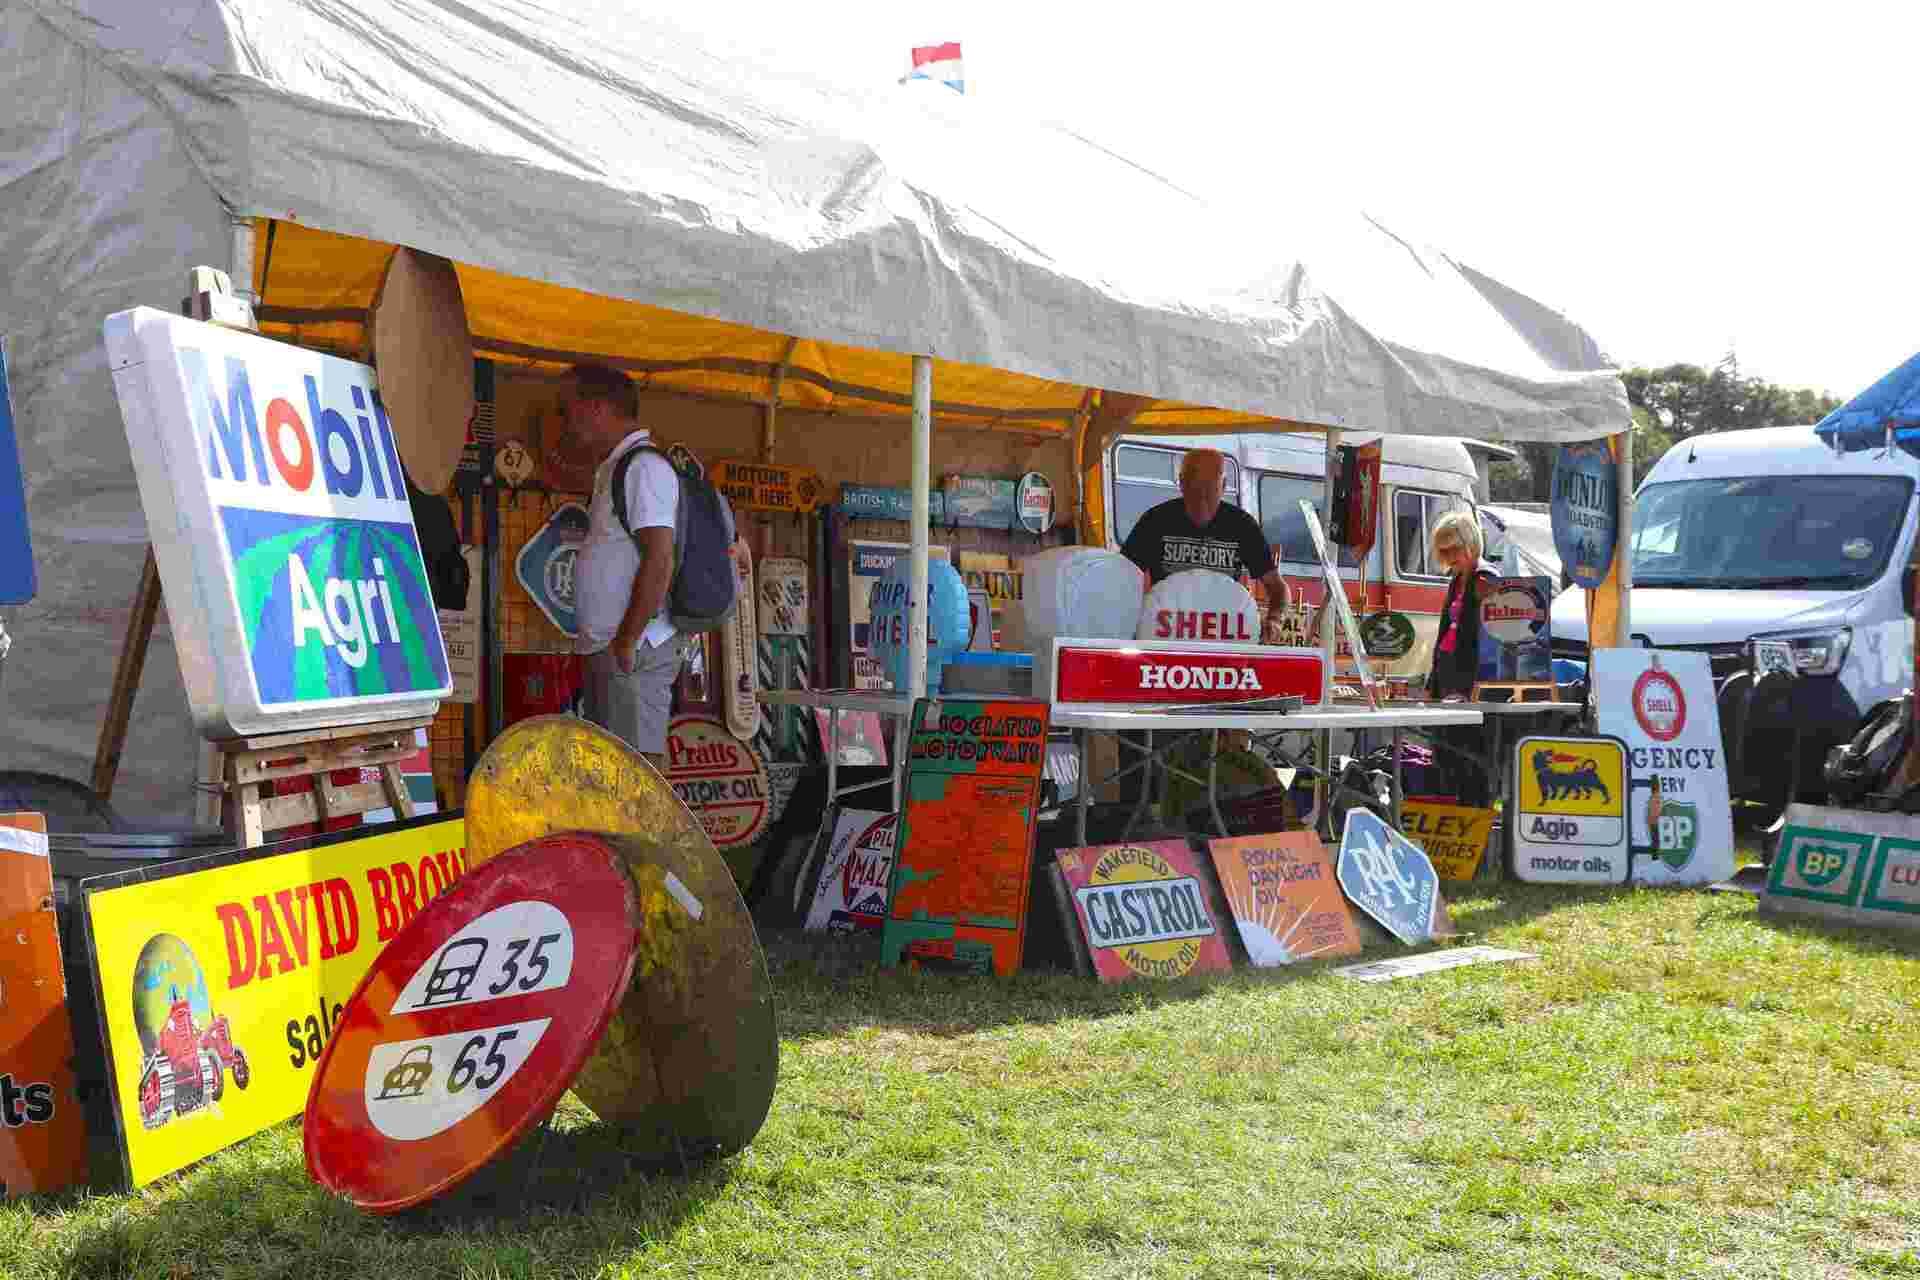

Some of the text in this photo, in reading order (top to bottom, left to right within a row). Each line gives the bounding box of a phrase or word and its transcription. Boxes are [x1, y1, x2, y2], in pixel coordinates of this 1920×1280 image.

[177, 347, 406, 504] Mobil
[289, 554, 400, 669] Agri
[1154, 609, 1251, 640] SHELL
[1139, 664, 1262, 691] HONDA
[667, 735, 738, 767] Pratts
[1627, 747, 1717, 771] GENCY
[732, 776, 765, 799] OIL
[1531, 816, 1578, 840] Agip
[1656, 814, 1694, 850] BP
[1095, 848, 1169, 880] WAKEFIELD
[1530, 855, 1612, 873] motor oils
[1804, 851, 1841, 877] BP
[216, 847, 466, 990] DAVID BROW
[1087, 884, 1210, 940] CASTROL
[489, 933, 561, 995] 35
[1125, 941, 1200, 976] MOTOR OIL
[447, 1030, 518, 1094] 65
